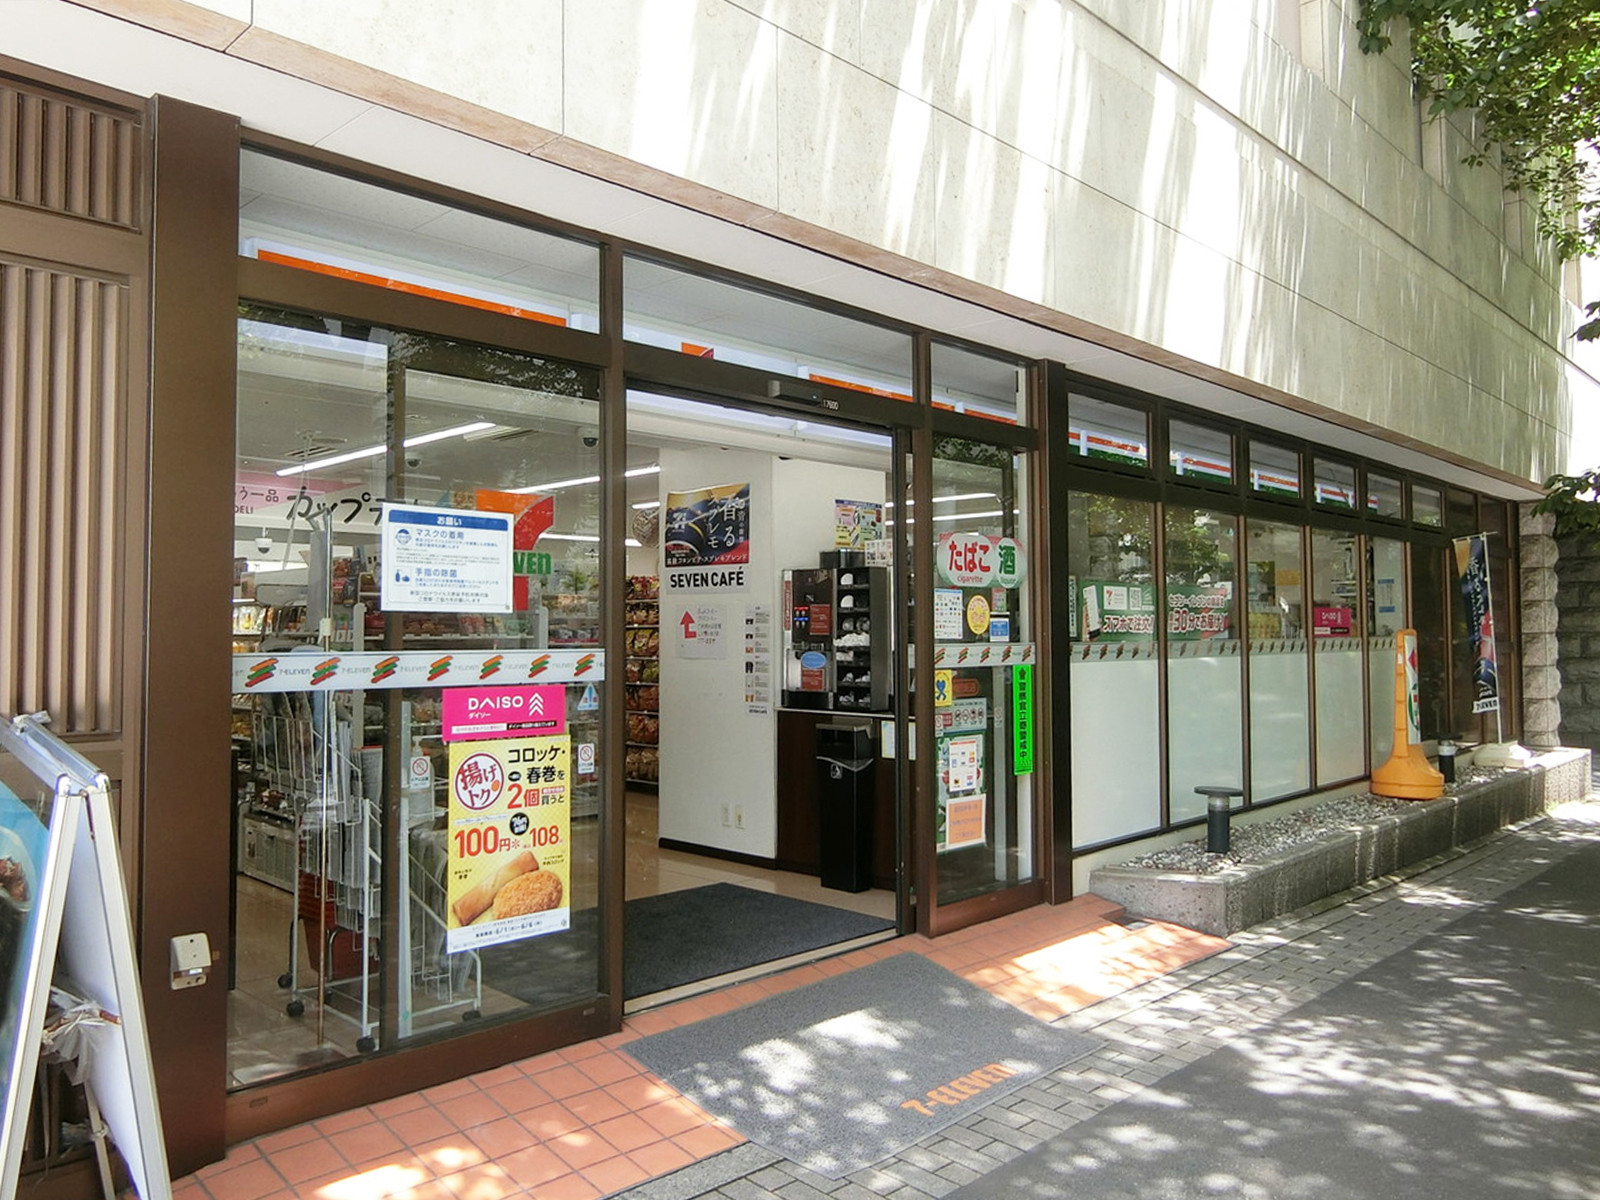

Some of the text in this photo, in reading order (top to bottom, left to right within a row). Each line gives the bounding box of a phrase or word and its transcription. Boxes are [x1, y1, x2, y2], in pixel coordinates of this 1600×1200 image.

[949, 541, 991, 573] たばこ
[998, 545, 1016, 575] 酒
[670, 565, 745, 588] SEVEN CAFÉ
[467, 695, 524, 710] DAISO
[468, 711, 491, 720] ダイソー
[459, 761, 497, 791] 揚げ
[526, 765, 565, 785] 春巻を
[468, 788, 491, 807] トク
[506, 783, 540, 810] 2個
